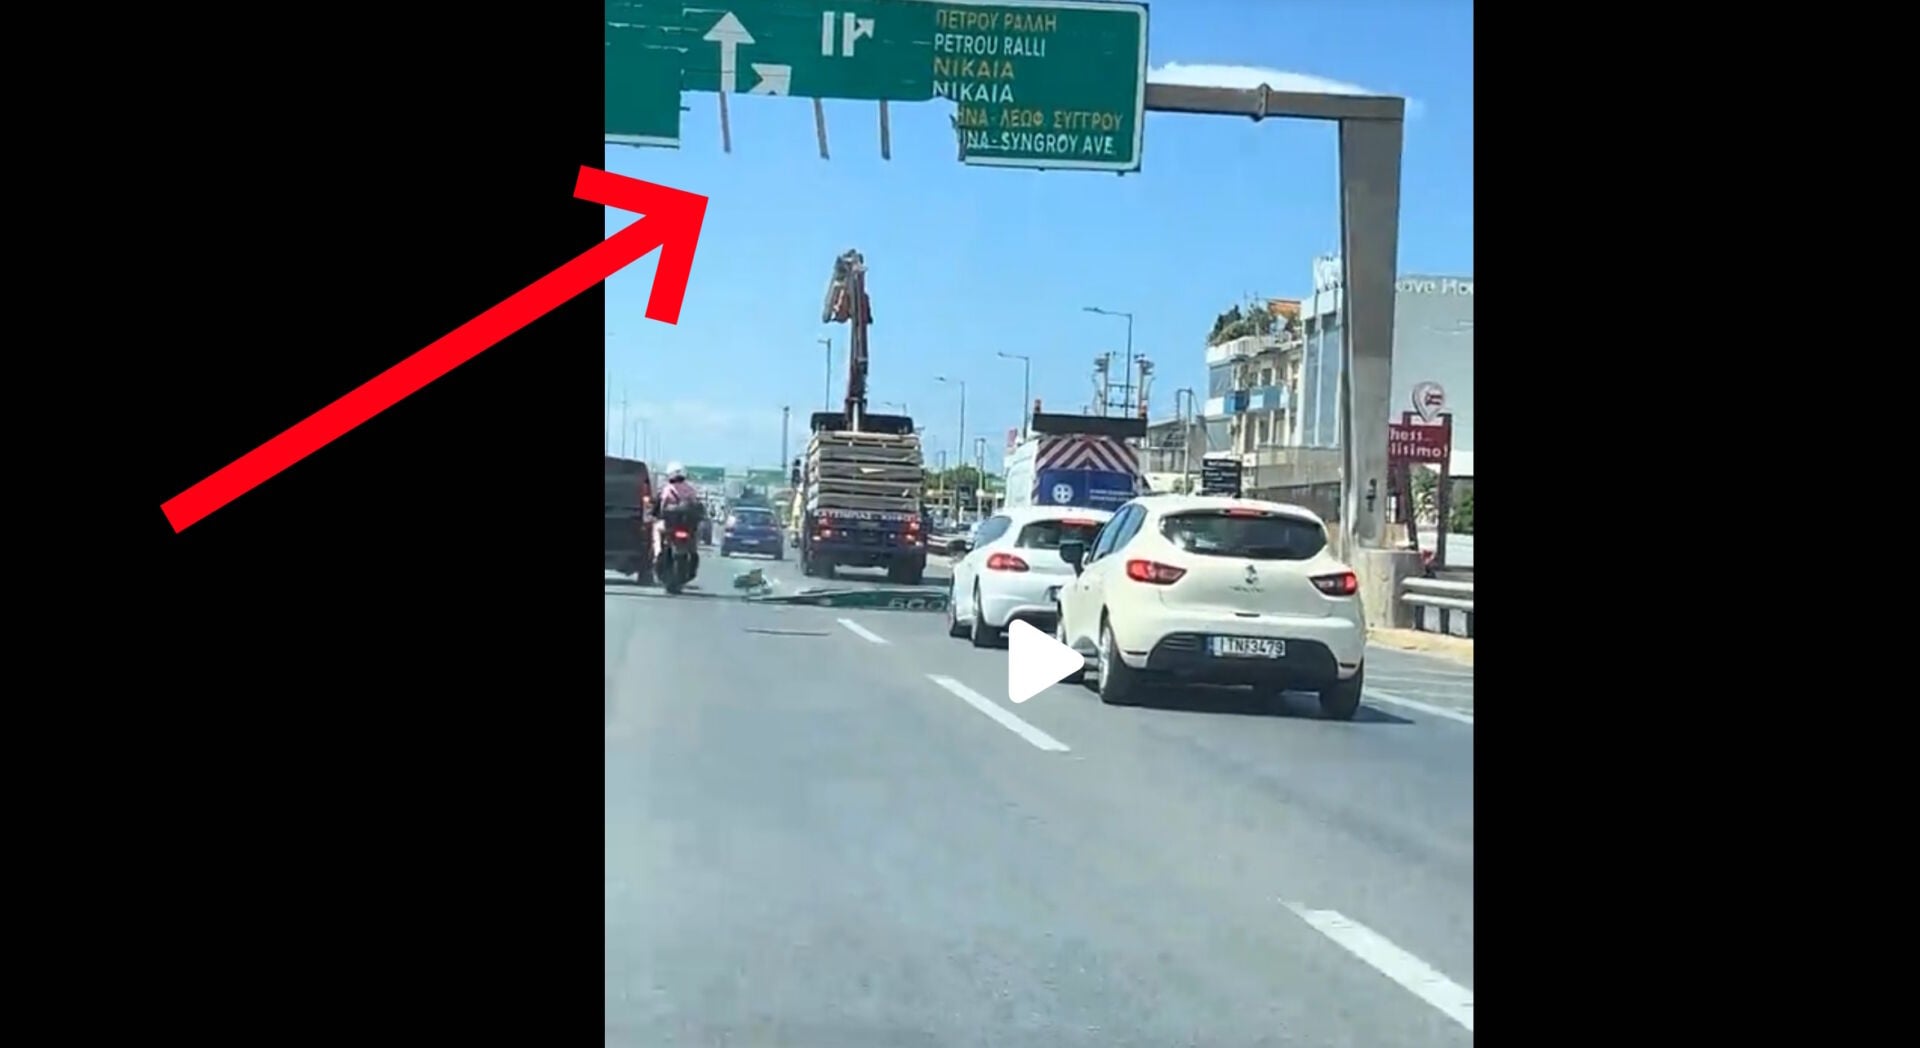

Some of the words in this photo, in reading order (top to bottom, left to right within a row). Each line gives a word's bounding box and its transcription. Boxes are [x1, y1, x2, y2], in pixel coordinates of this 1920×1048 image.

[1004, 13, 1057, 32] ΡΑΛΛΗ
[934, 33, 998, 55] PETROU
[1003, 36, 1046, 57] RALLI
[934, 57, 1015, 79] ΝΙΚΑΙΑ
[932, 80, 1014, 103] NIKAIA
[1052, 111, 1123, 131] ΣΥΓΓΡΟΥ
